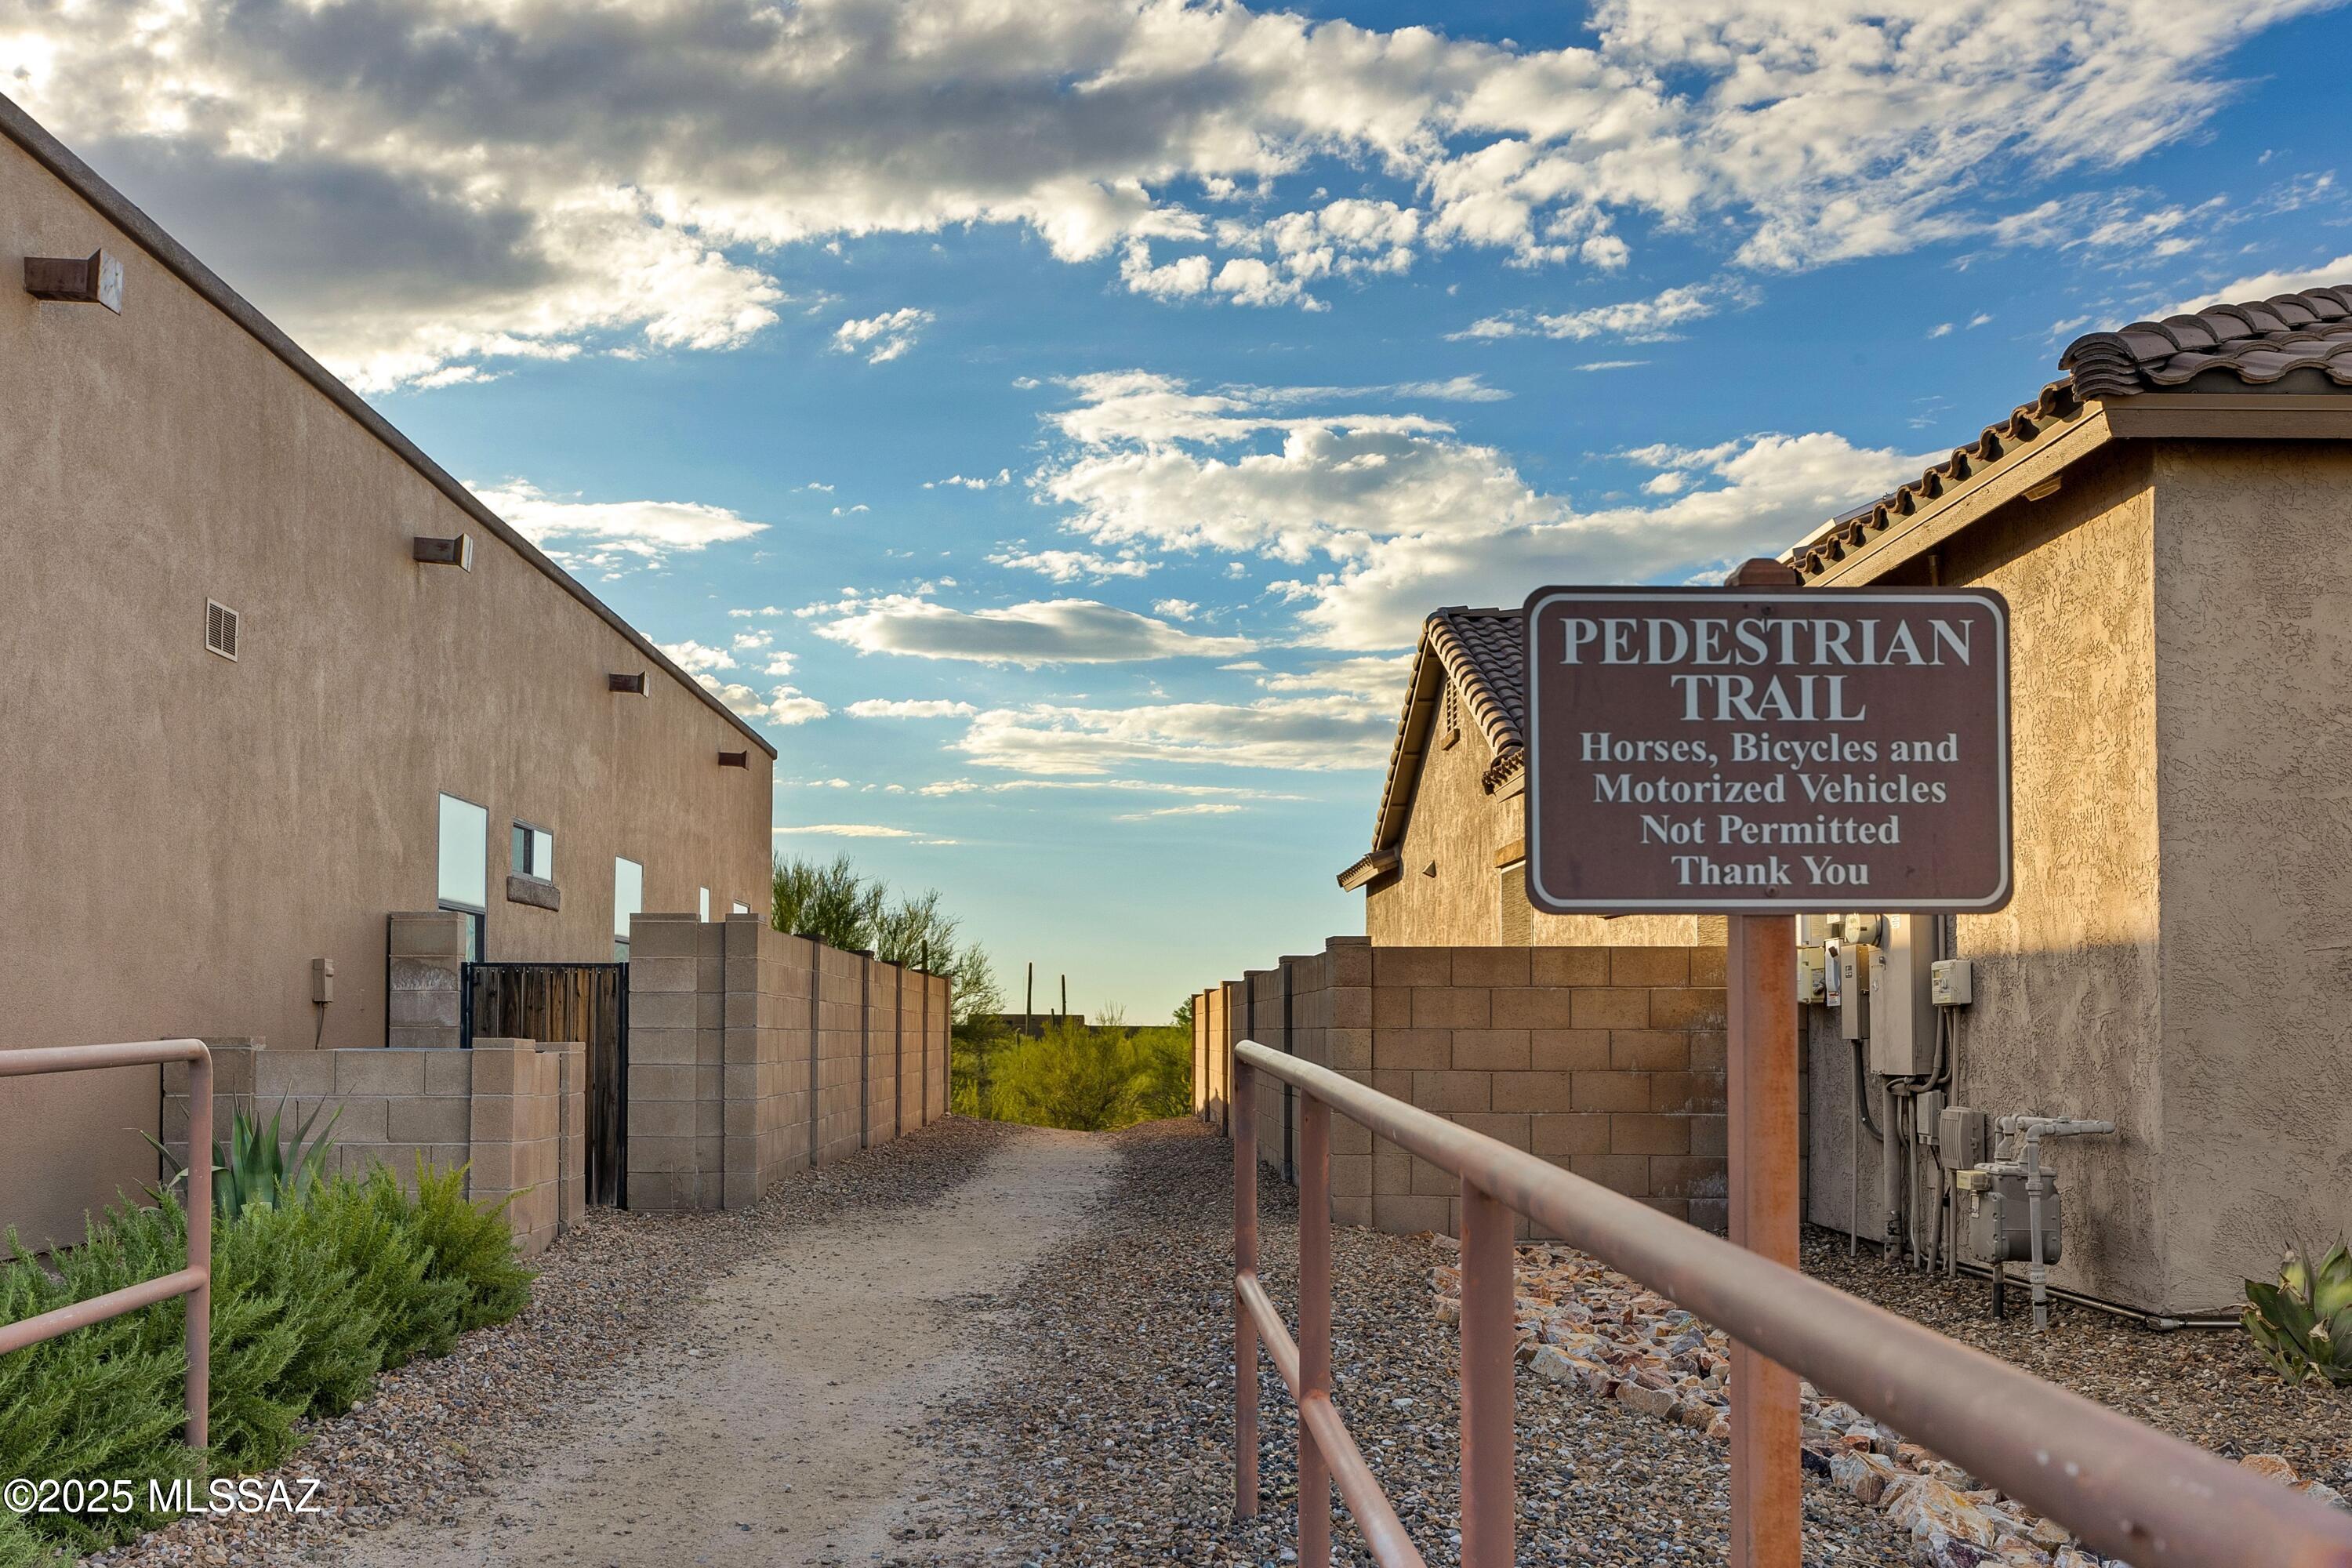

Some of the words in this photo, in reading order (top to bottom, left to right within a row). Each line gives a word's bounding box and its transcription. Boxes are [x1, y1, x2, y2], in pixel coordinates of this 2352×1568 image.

[1560, 618, 1974, 666] PEDESTRIAN
[1671, 674, 1866, 721] TRAIL
[1580, 732, 1718, 768] Horses,
[1731, 732, 1878, 770] Bicycles
[1890, 732, 1959, 762] and
[1593, 773, 1786, 803] Motorized
[1798, 773, 1947, 804] Vehicles
[1640, 815, 1706, 844] Not
[1718, 814, 1901, 844] Permitted
[1671, 855, 1792, 885] Thank
[1801, 855, 1870, 885] You
